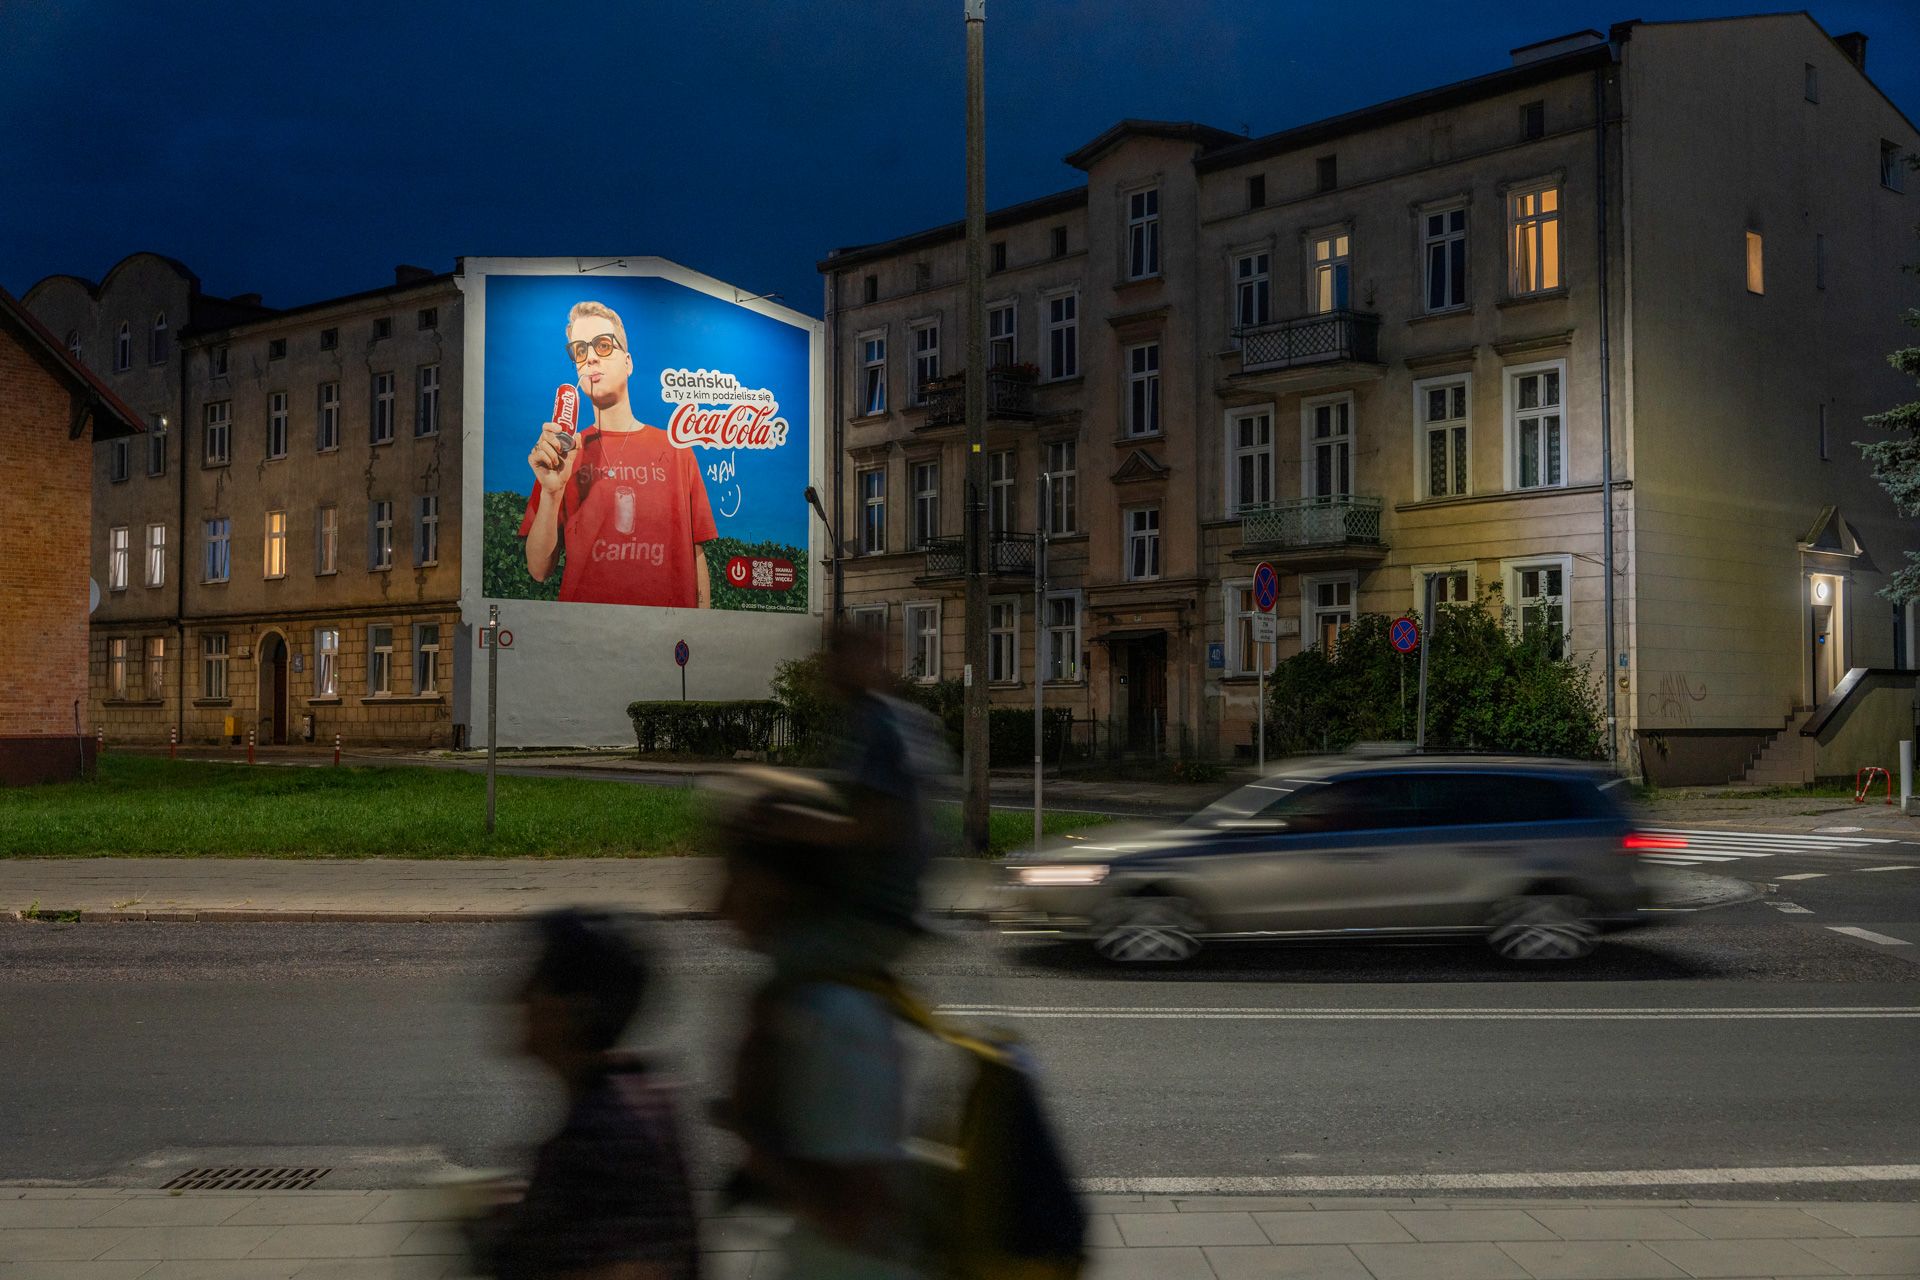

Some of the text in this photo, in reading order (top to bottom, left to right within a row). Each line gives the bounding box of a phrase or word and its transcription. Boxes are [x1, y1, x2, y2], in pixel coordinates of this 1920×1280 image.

[664, 372, 738, 391] Gdańsku,
[673, 389, 684, 400] Ty
[694, 390, 710, 399] kim
[712, 389, 756, 402] podzielisz
[758, 391, 771, 402] się
[557, 391, 575, 430] Janek
[651, 462, 666, 481] is
[592, 537, 664, 566] Caring
